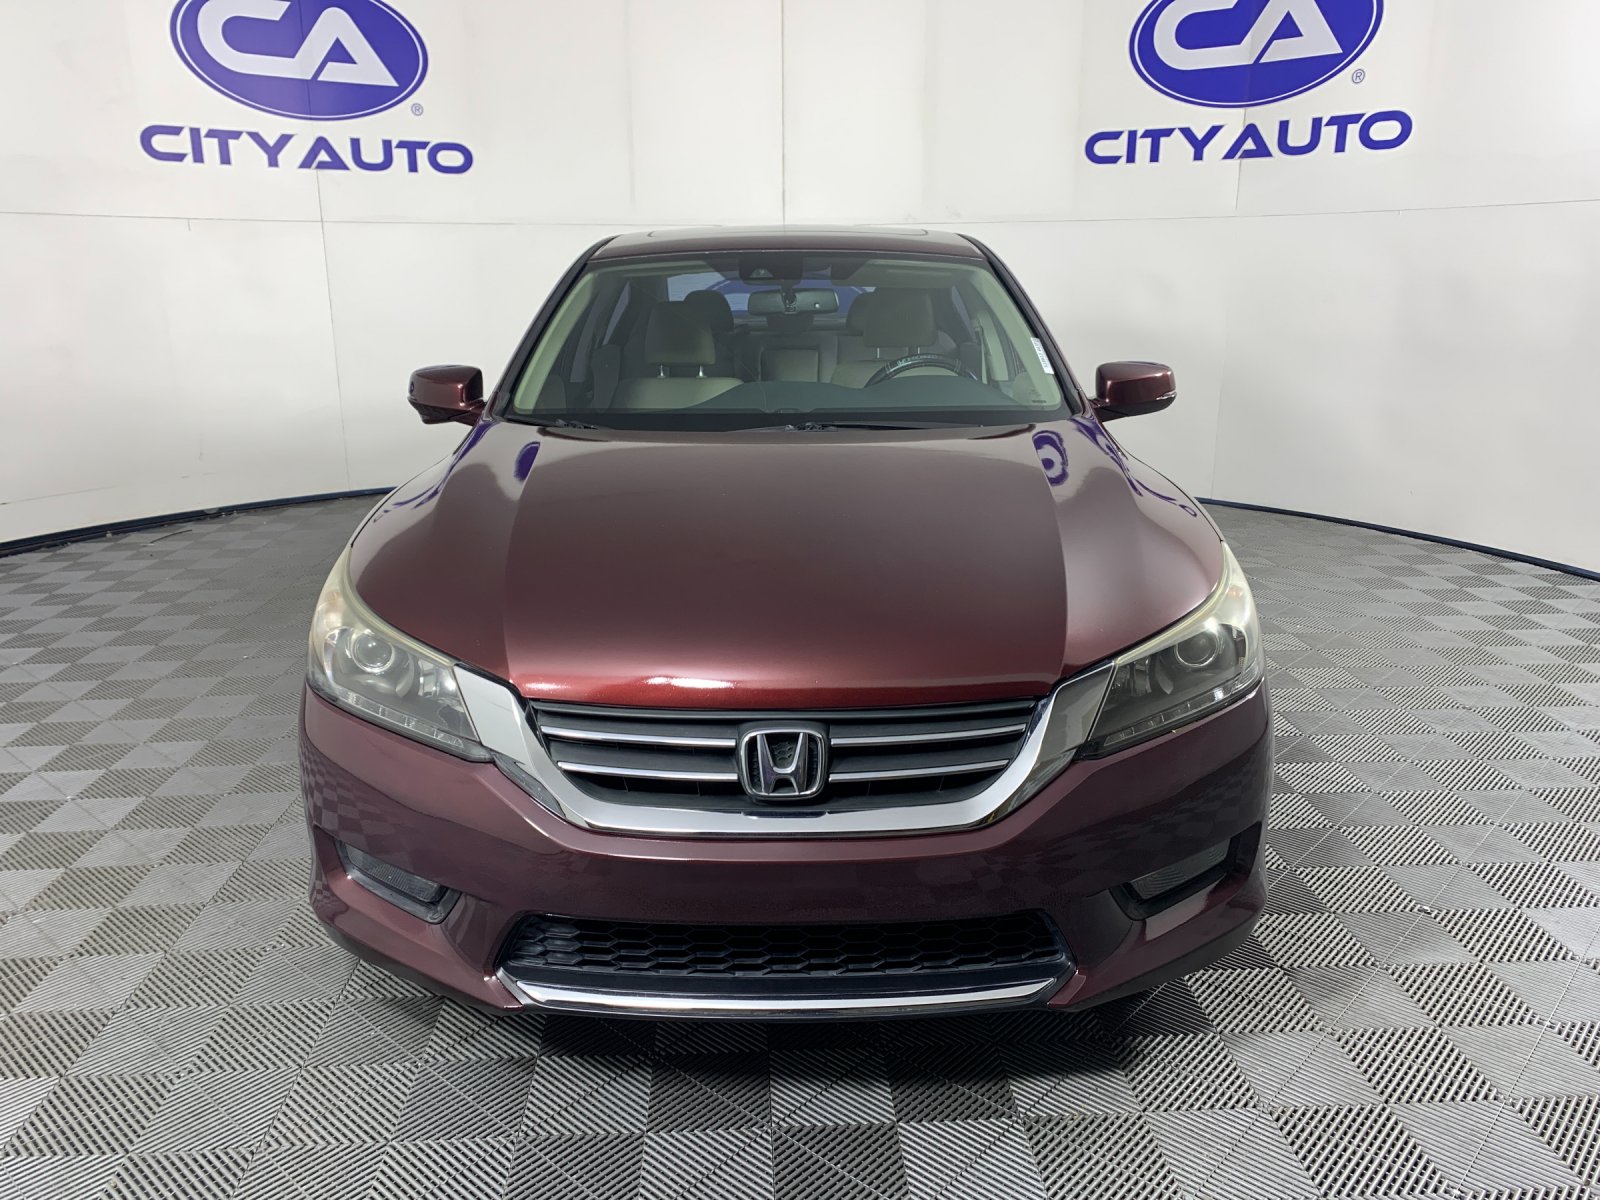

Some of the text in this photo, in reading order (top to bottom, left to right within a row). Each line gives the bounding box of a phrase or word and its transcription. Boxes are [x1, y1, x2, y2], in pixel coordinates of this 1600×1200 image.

[197, 0, 399, 87] CA
[1153, 0, 1343, 71] CA
[140, 125, 474, 175] CITY AUTO
[1084, 110, 1413, 165] CITY AUTO
